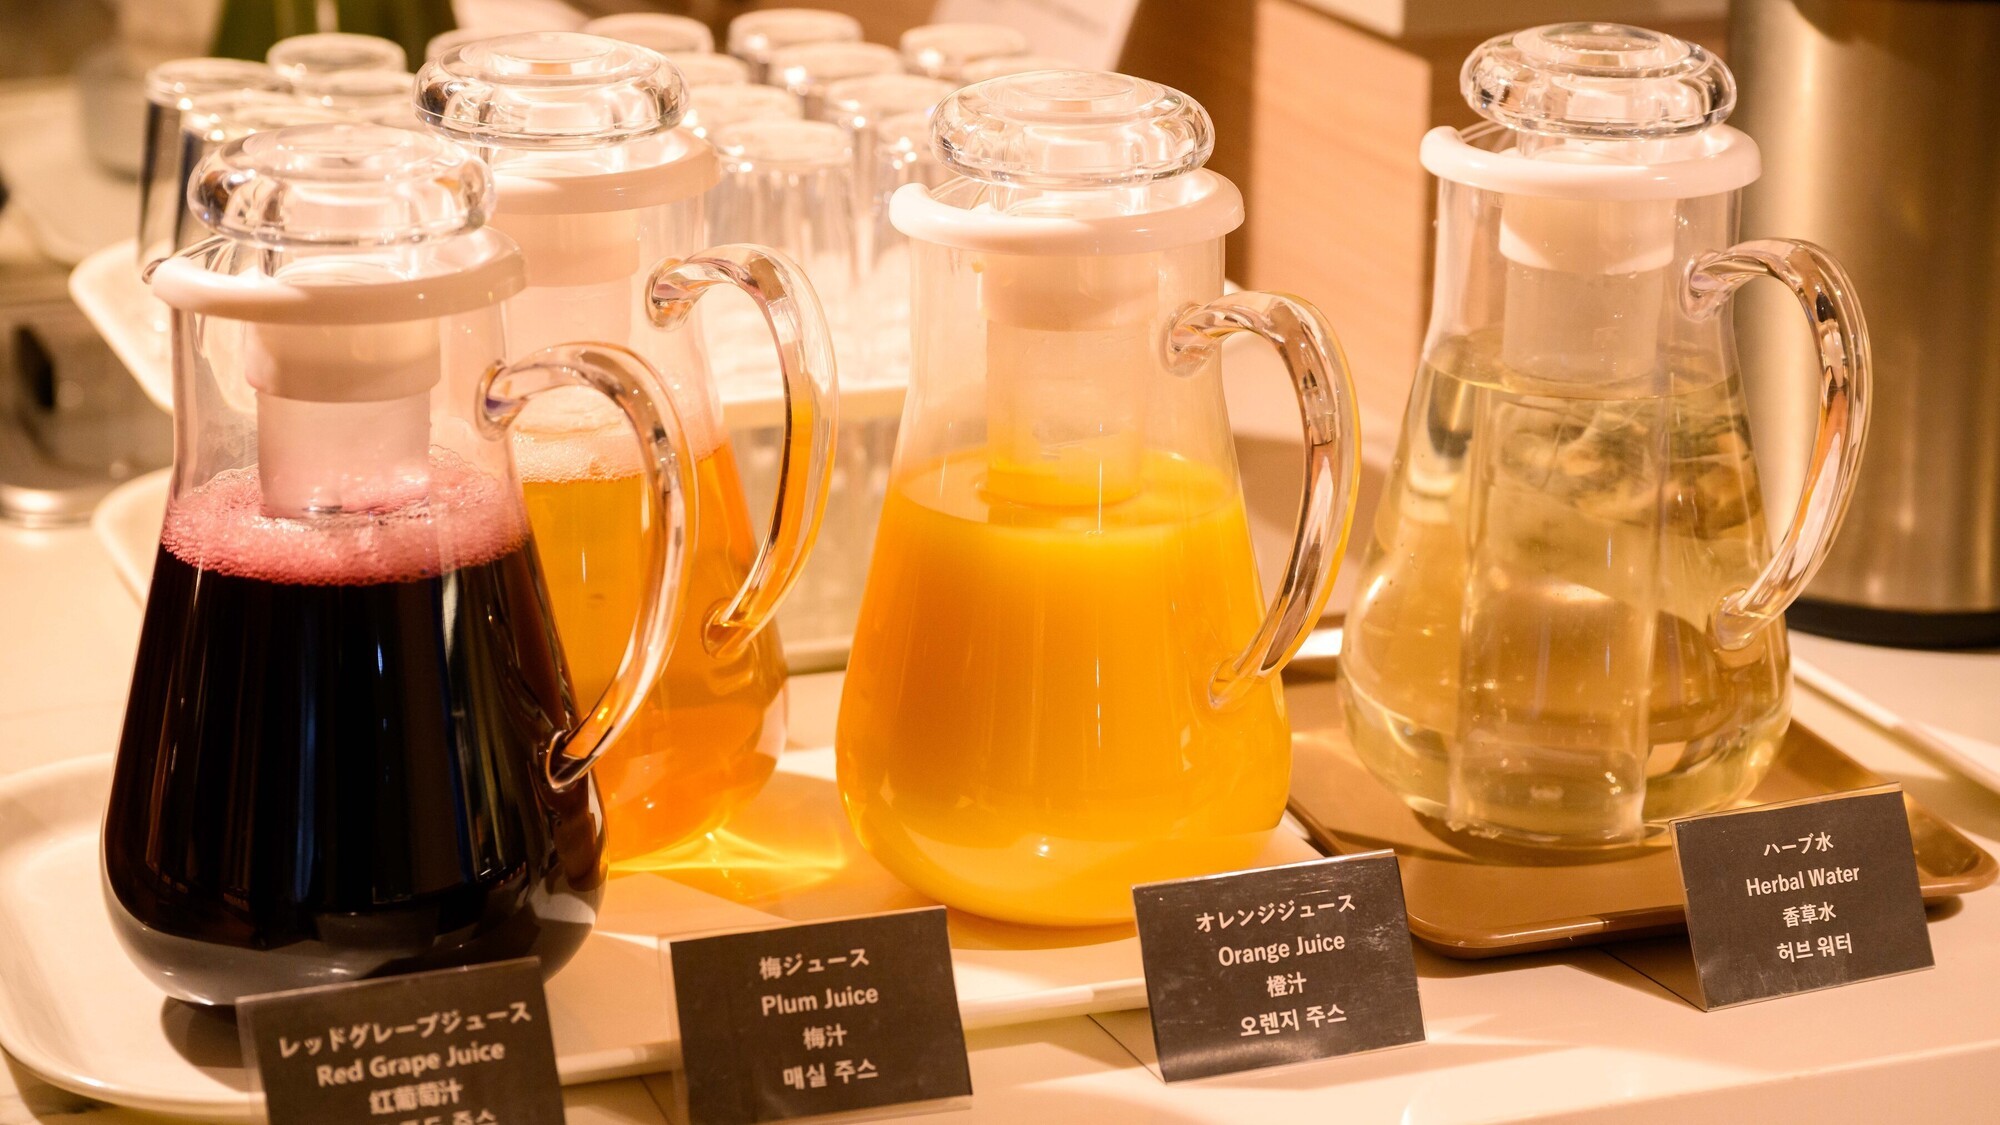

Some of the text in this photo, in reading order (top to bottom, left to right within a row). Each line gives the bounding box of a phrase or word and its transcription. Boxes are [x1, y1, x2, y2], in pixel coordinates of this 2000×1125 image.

[1763, 831, 1834, 856] ハーブ水
[1746, 866, 1860, 897] Herbal Water
[1196, 894, 1356, 933] オレンジジュース
[1783, 901, 1836, 928] 香草水
[1218, 933, 1346, 967] Orange Juice
[1776, 932, 1853, 963] 허브 워터
[759, 948, 870, 980] 梅ジュース
[1266, 972, 1307, 998] 橙汁
[761, 986, 879, 1016] Plum Juice
[278, 1001, 533, 1059] レッドグレープジュース
[1240, 1003, 1347, 1037] 오렌지 주스
[802, 1023, 848, 1050] 梅汁
[316, 1041, 505, 1087] Red Grape Juice
[782, 1058, 879, 1090] 매실 주스
